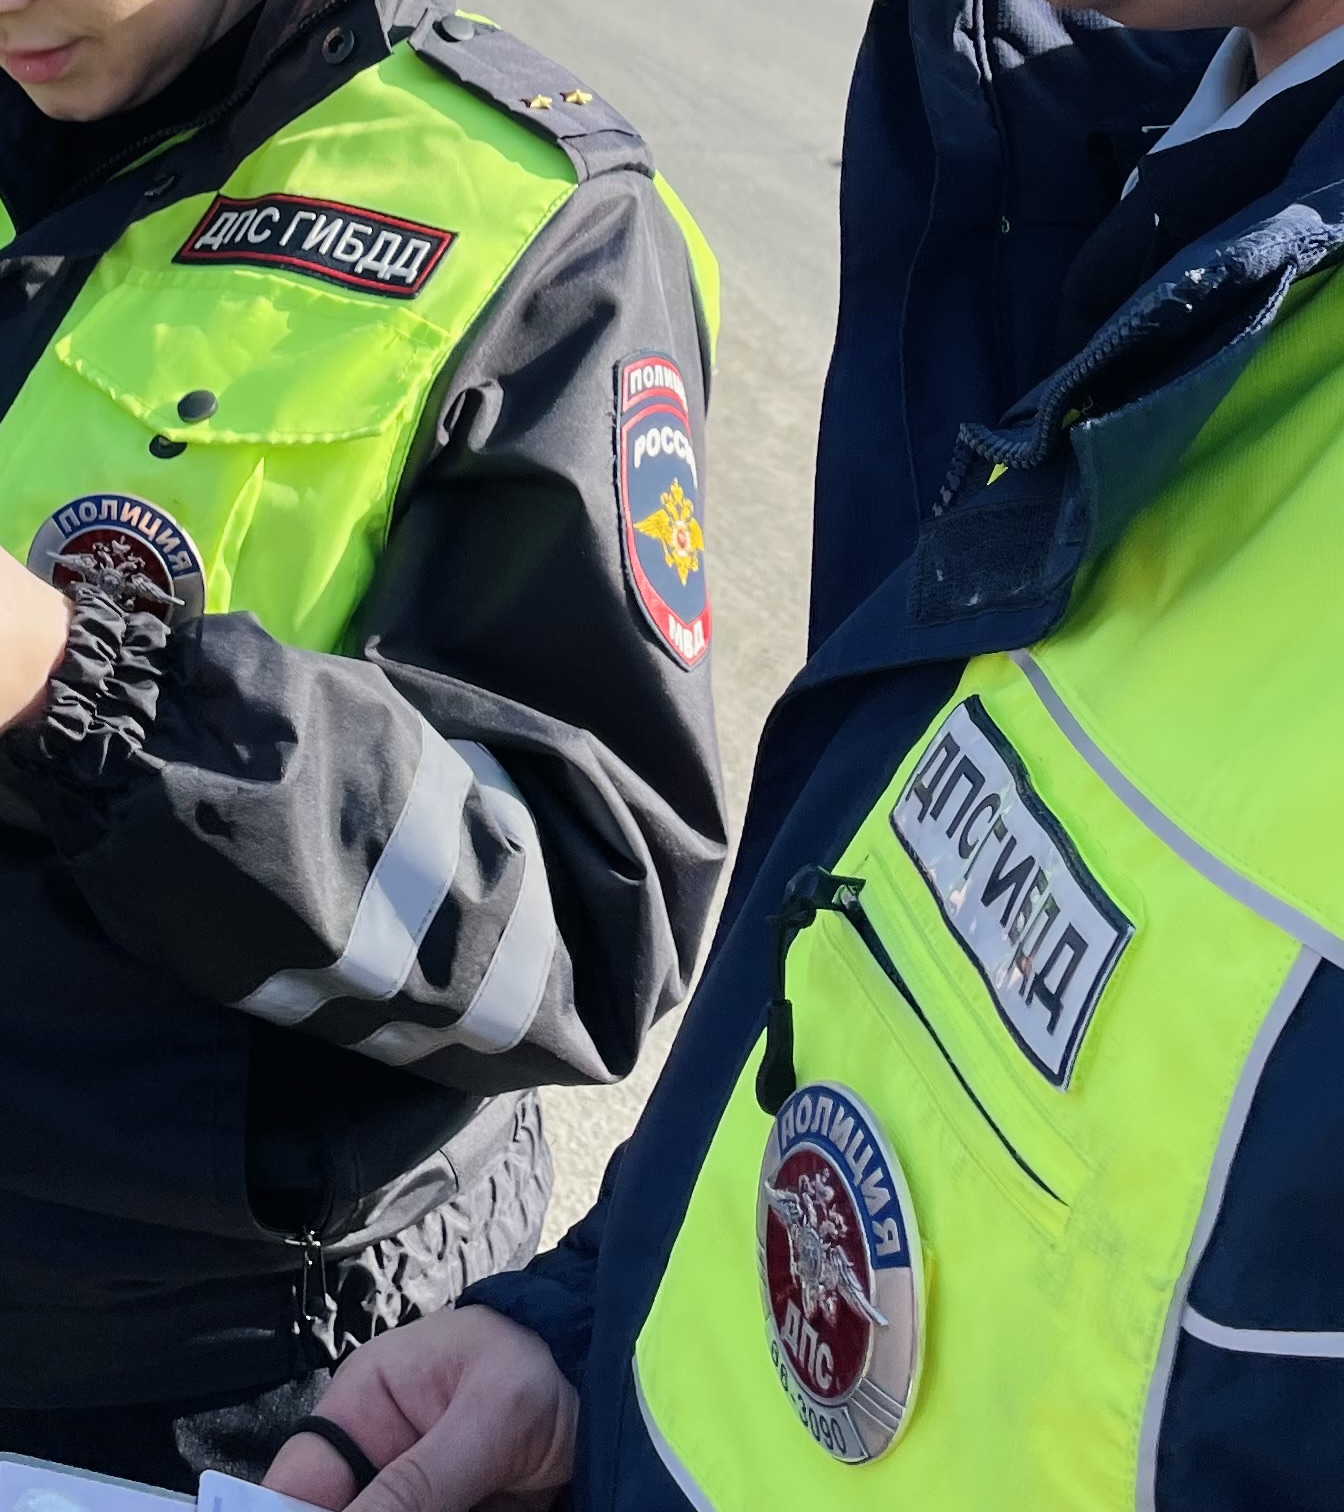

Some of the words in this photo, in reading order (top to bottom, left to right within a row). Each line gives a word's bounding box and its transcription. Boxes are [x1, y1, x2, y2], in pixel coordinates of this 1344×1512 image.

[194, 206, 280, 251] ДПС
[279, 210, 432, 285] ГИБДД
[58, 499, 193, 572] ПОЛИЦИЯ
[668, 613, 705, 659] МВД
[905, 731, 1001, 861] ДПС
[781, 1094, 902, 1258] ПОЛИЦИЯ
[780, 1297, 835, 1391] ДПС
